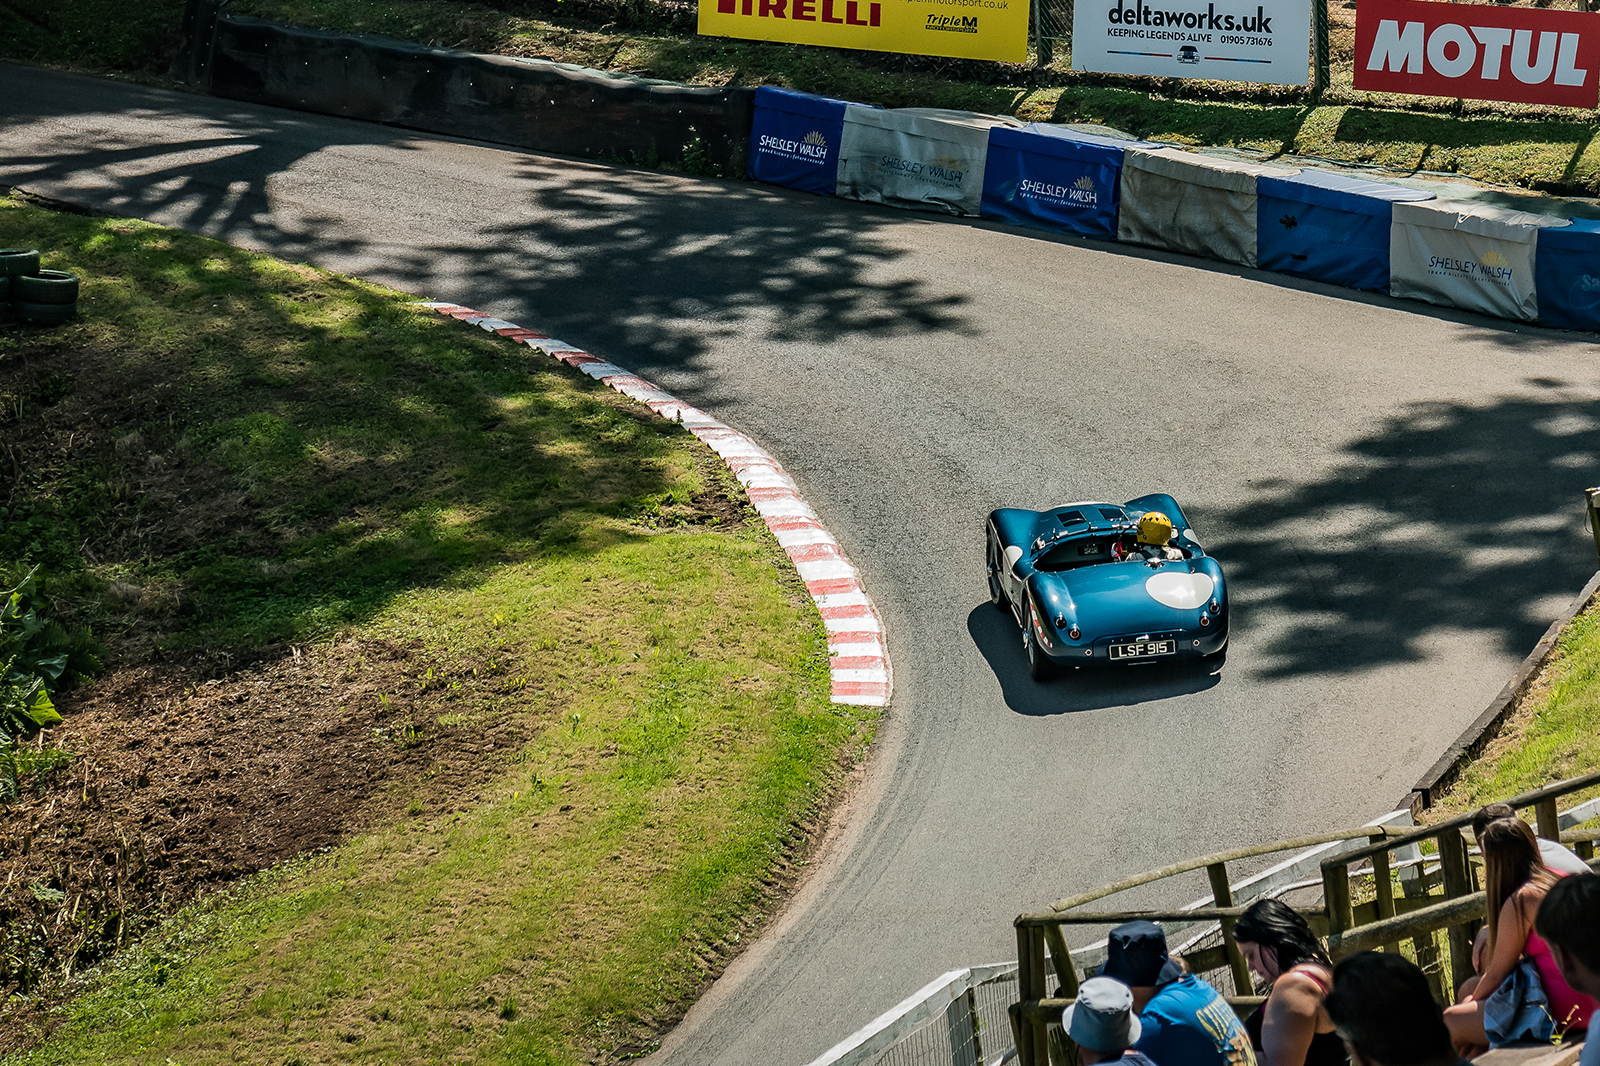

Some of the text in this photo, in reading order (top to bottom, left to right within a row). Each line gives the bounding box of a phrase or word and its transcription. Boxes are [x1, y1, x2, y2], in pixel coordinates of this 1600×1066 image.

[899, 0, 1009, 9] mmotorsport.co.uk
[1108, 0, 1272, 33] deltaworks.uk
[1107, 28, 1212, 43] KEEPING LEGENDS ALIVE
[1220, 35, 1272, 46] 01905 731676
[1366, 19, 1588, 87] MOTUL
[759, 134, 828, 159] SHELSLEY WALSH
[881, 155, 925, 174] SHELSLEY
[928, 165, 964, 182] WALSH
[1020, 179, 1097, 203] SHELSLEY WALSH
[1429, 256, 1513, 280] SHELSLEY WALSH
[1118, 642, 1168, 657] LSF 915
